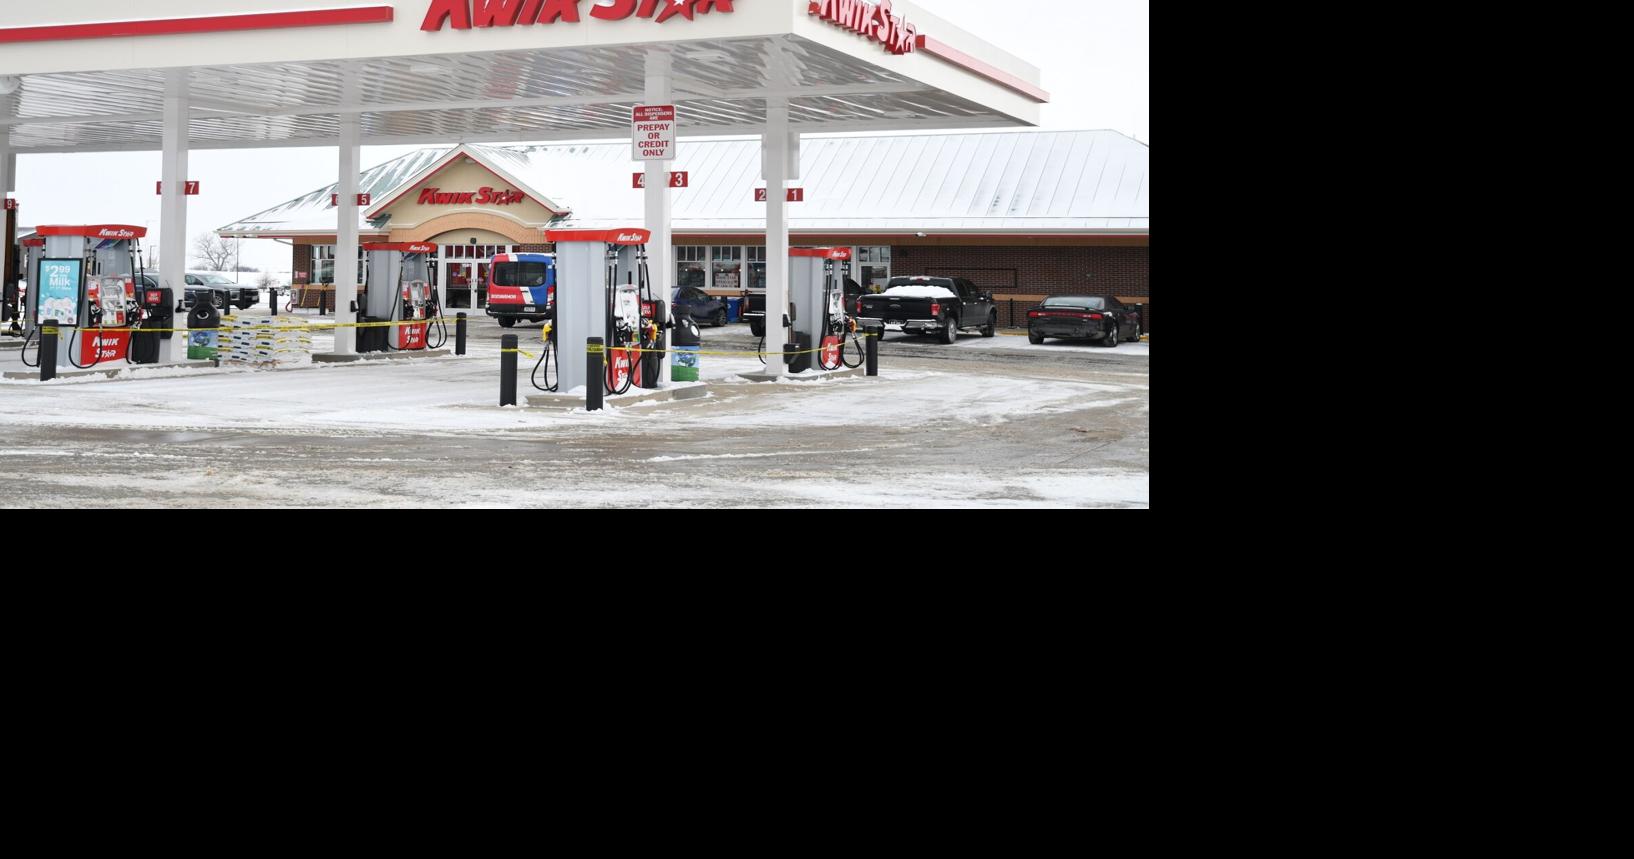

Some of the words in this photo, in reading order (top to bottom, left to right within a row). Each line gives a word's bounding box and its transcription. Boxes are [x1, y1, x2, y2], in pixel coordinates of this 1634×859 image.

[637, 123, 670, 131] PREPAY
[638, 140, 669, 148] CREDIT
[675, 172, 683, 187] 3
[188, 182, 196, 194] 7
[361, 194, 367, 205] 5
[417, 187, 476, 205] KWIK
[476, 186, 524, 205] STAR
[758, 189, 766, 201] 2
[791, 189, 798, 201] 1
[49, 277, 71, 286] Milk
